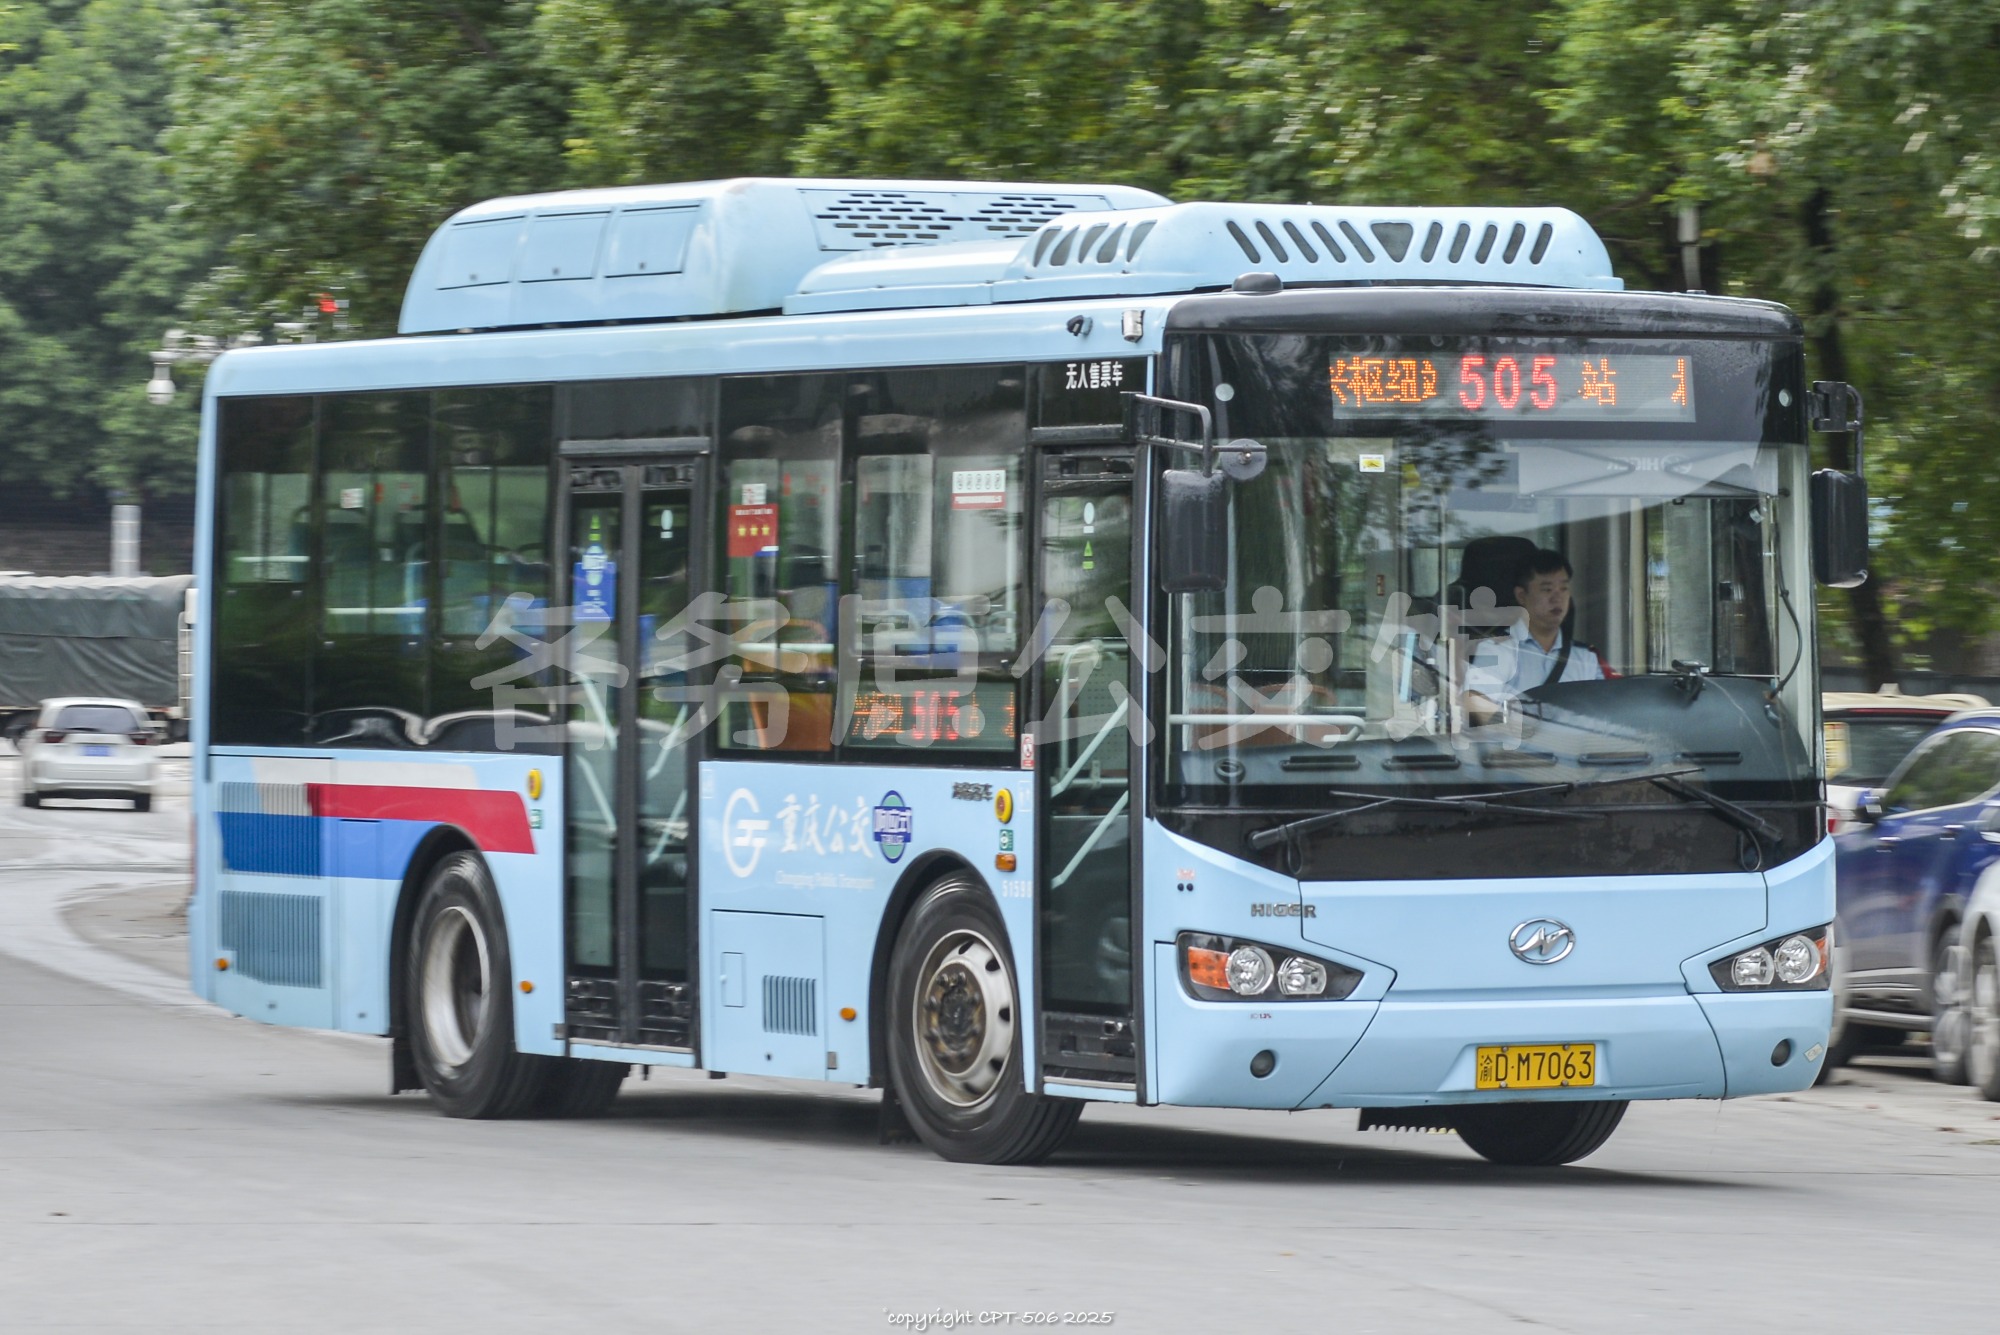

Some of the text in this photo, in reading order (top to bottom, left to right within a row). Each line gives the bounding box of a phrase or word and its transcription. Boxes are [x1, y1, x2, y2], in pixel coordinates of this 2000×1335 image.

[1065, 361, 1123, 390] 无人售票车
[1459, 355, 1557, 410] 505
[775, 793, 874, 859] 重庆公交
[1250, 903, 1317, 918] HIGER
